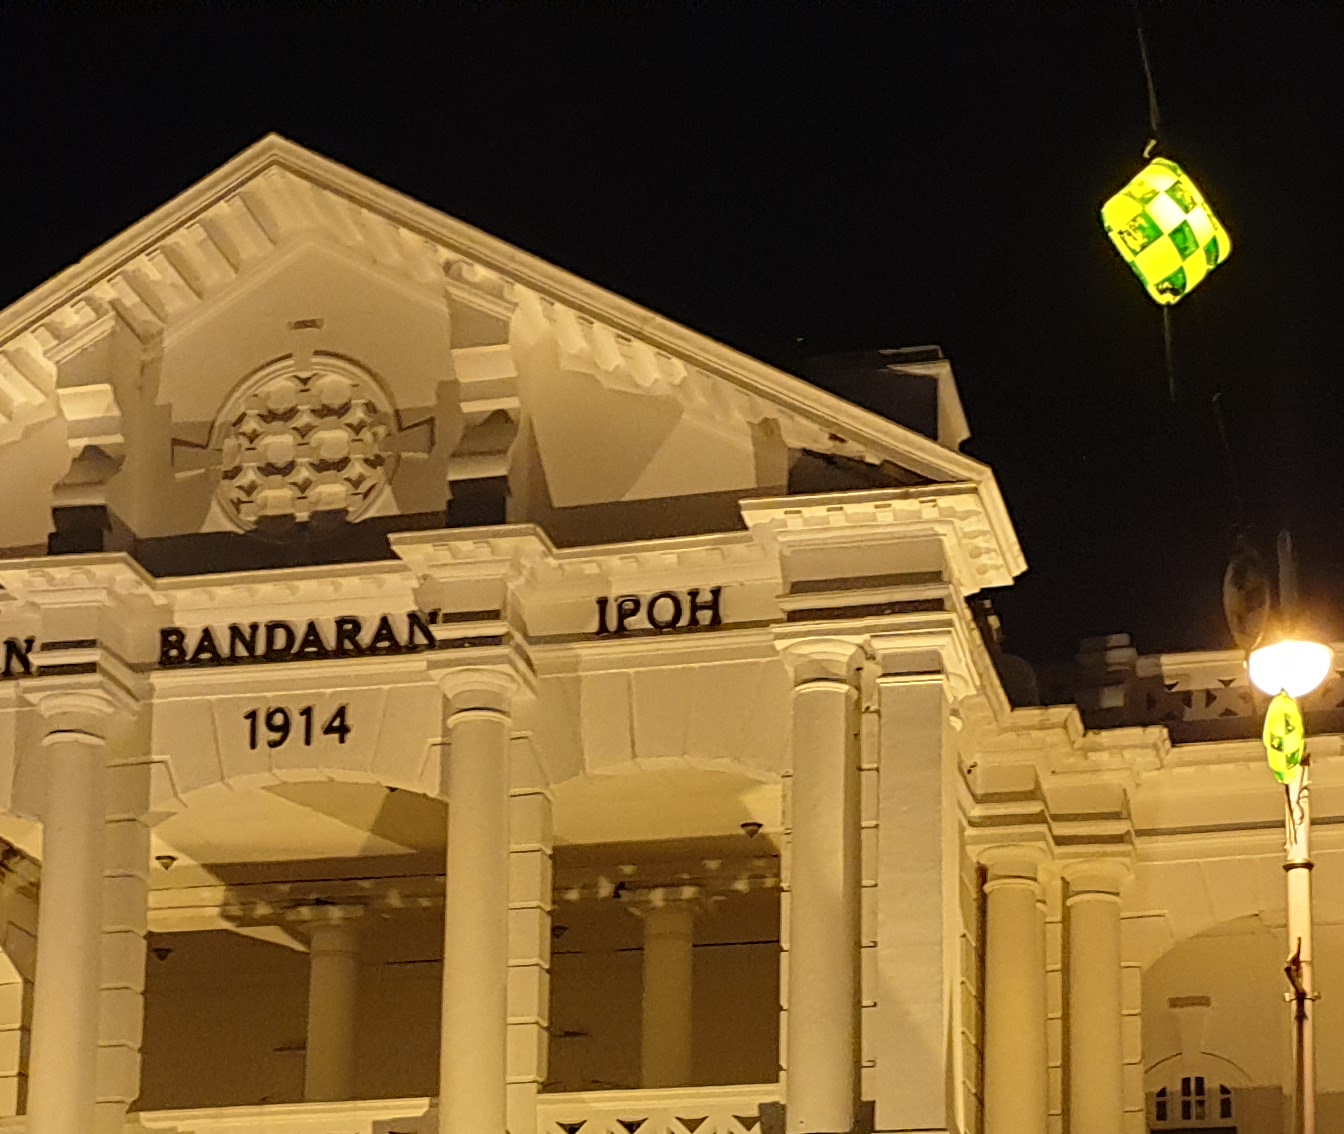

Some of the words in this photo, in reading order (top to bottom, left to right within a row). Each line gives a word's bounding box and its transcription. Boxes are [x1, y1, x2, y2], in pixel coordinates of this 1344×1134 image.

[158, 608, 442, 667] BANDARAN
[595, 585, 723, 635] IPOH
[243, 702, 352, 750] 1914
